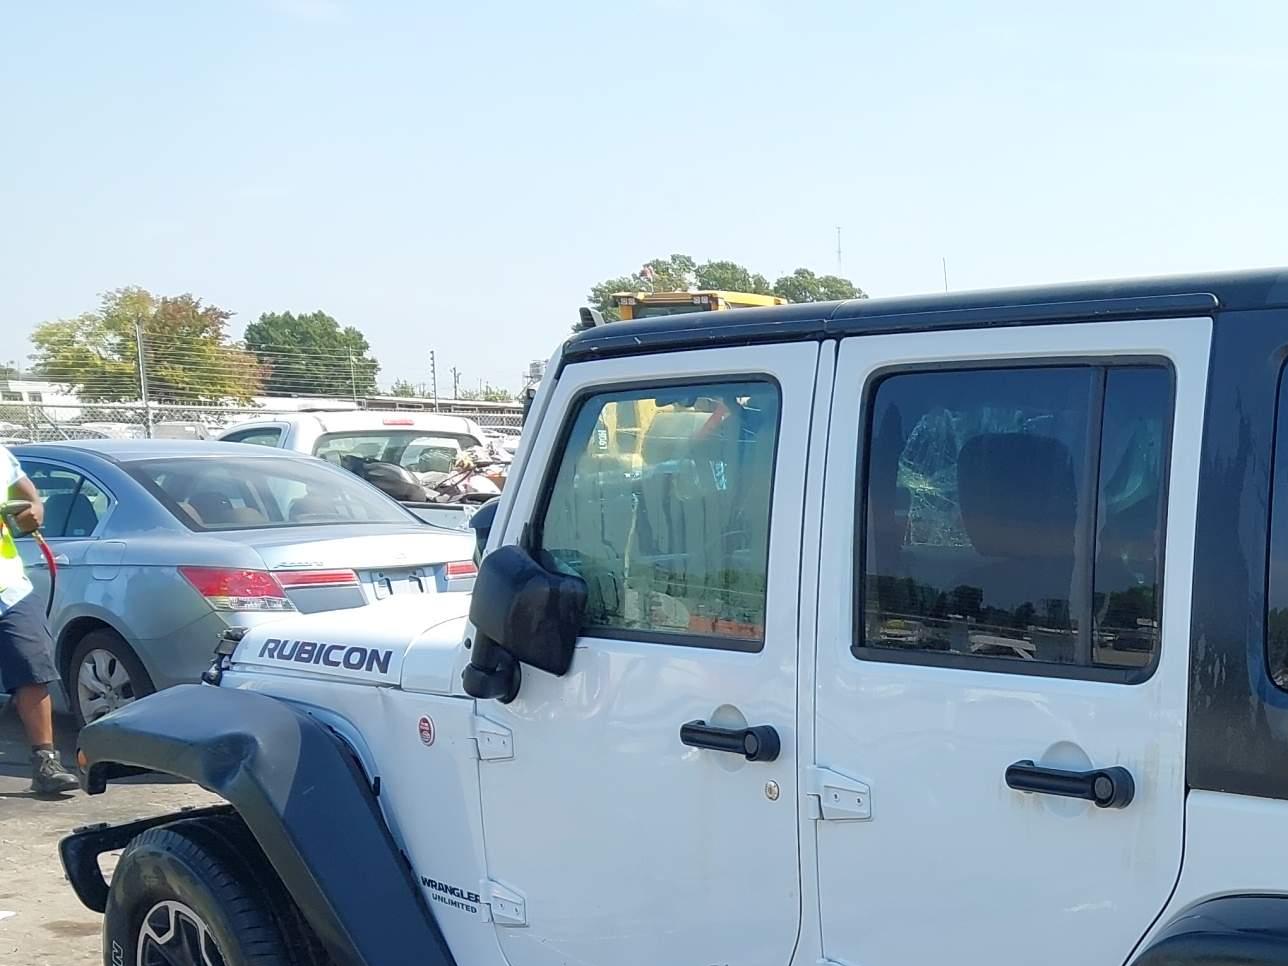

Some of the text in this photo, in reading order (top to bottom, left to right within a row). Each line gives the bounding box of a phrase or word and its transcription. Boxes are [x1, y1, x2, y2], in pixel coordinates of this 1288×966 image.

[258, 638, 393, 674] RUBICON
[420, 875, 481, 904] WRANGLER
[431, 893, 477, 914] UNLIMITED
